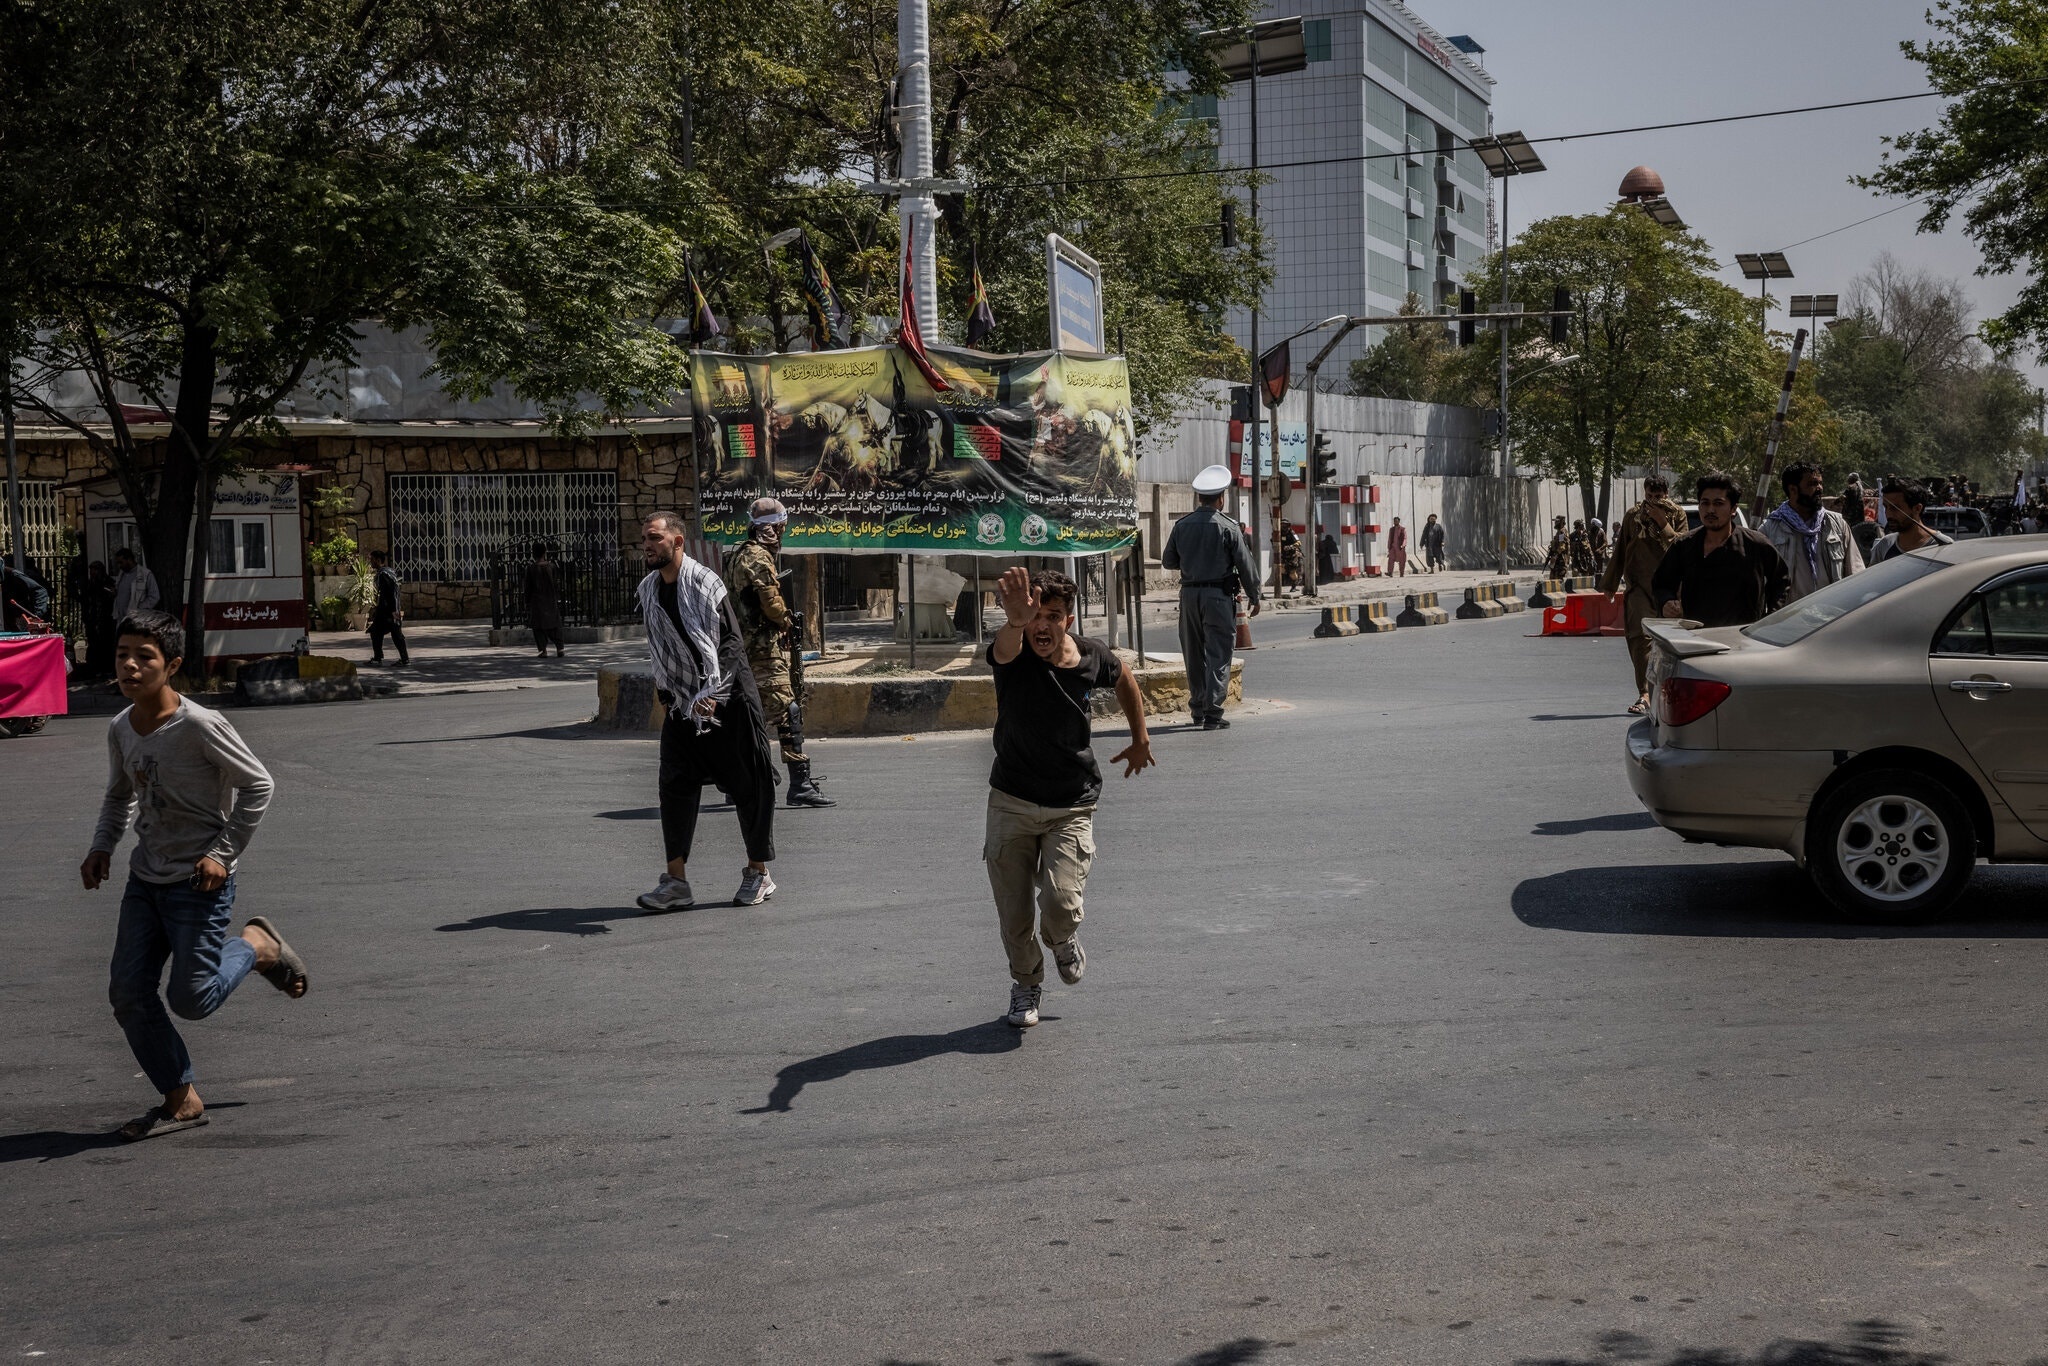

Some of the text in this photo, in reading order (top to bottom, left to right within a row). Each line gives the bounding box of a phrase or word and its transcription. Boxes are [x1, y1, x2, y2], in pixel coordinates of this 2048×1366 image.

[781, 488, 805, 501] پیشگاه
[805, 488, 814, 500] به
[814, 487, 822, 501] را
[823, 487, 847, 501] شمشیر
[847, 489, 857, 501] بر
[856, 487, 876, 501] خون
[876, 489, 906, 501] پیروزی
[907, 488, 921, 498] ماه
[950, 489, 966, 501] ایام
[1025, 492, 1044, 505] (عج)
[817, 502, 838, 514] عرض
[838, 501, 862, 514] تسلیت
[862, 501, 883, 514] جهان
[884, 502, 921, 514] مسلمانان
[922, 503, 941, 515] تمام
[941, 506, 948, 516] و
[789, 521, 807, 537] شهر
[807, 524, 828, 537] دهم
[852, 521, 885, 539] جوانان
[886, 522, 932, 538] اجتماعی
[932, 523, 967, 539] شورای
[1055, 526, 1074, 541] کابل
[222, 605, 279, 621] پولیس ترافیک
